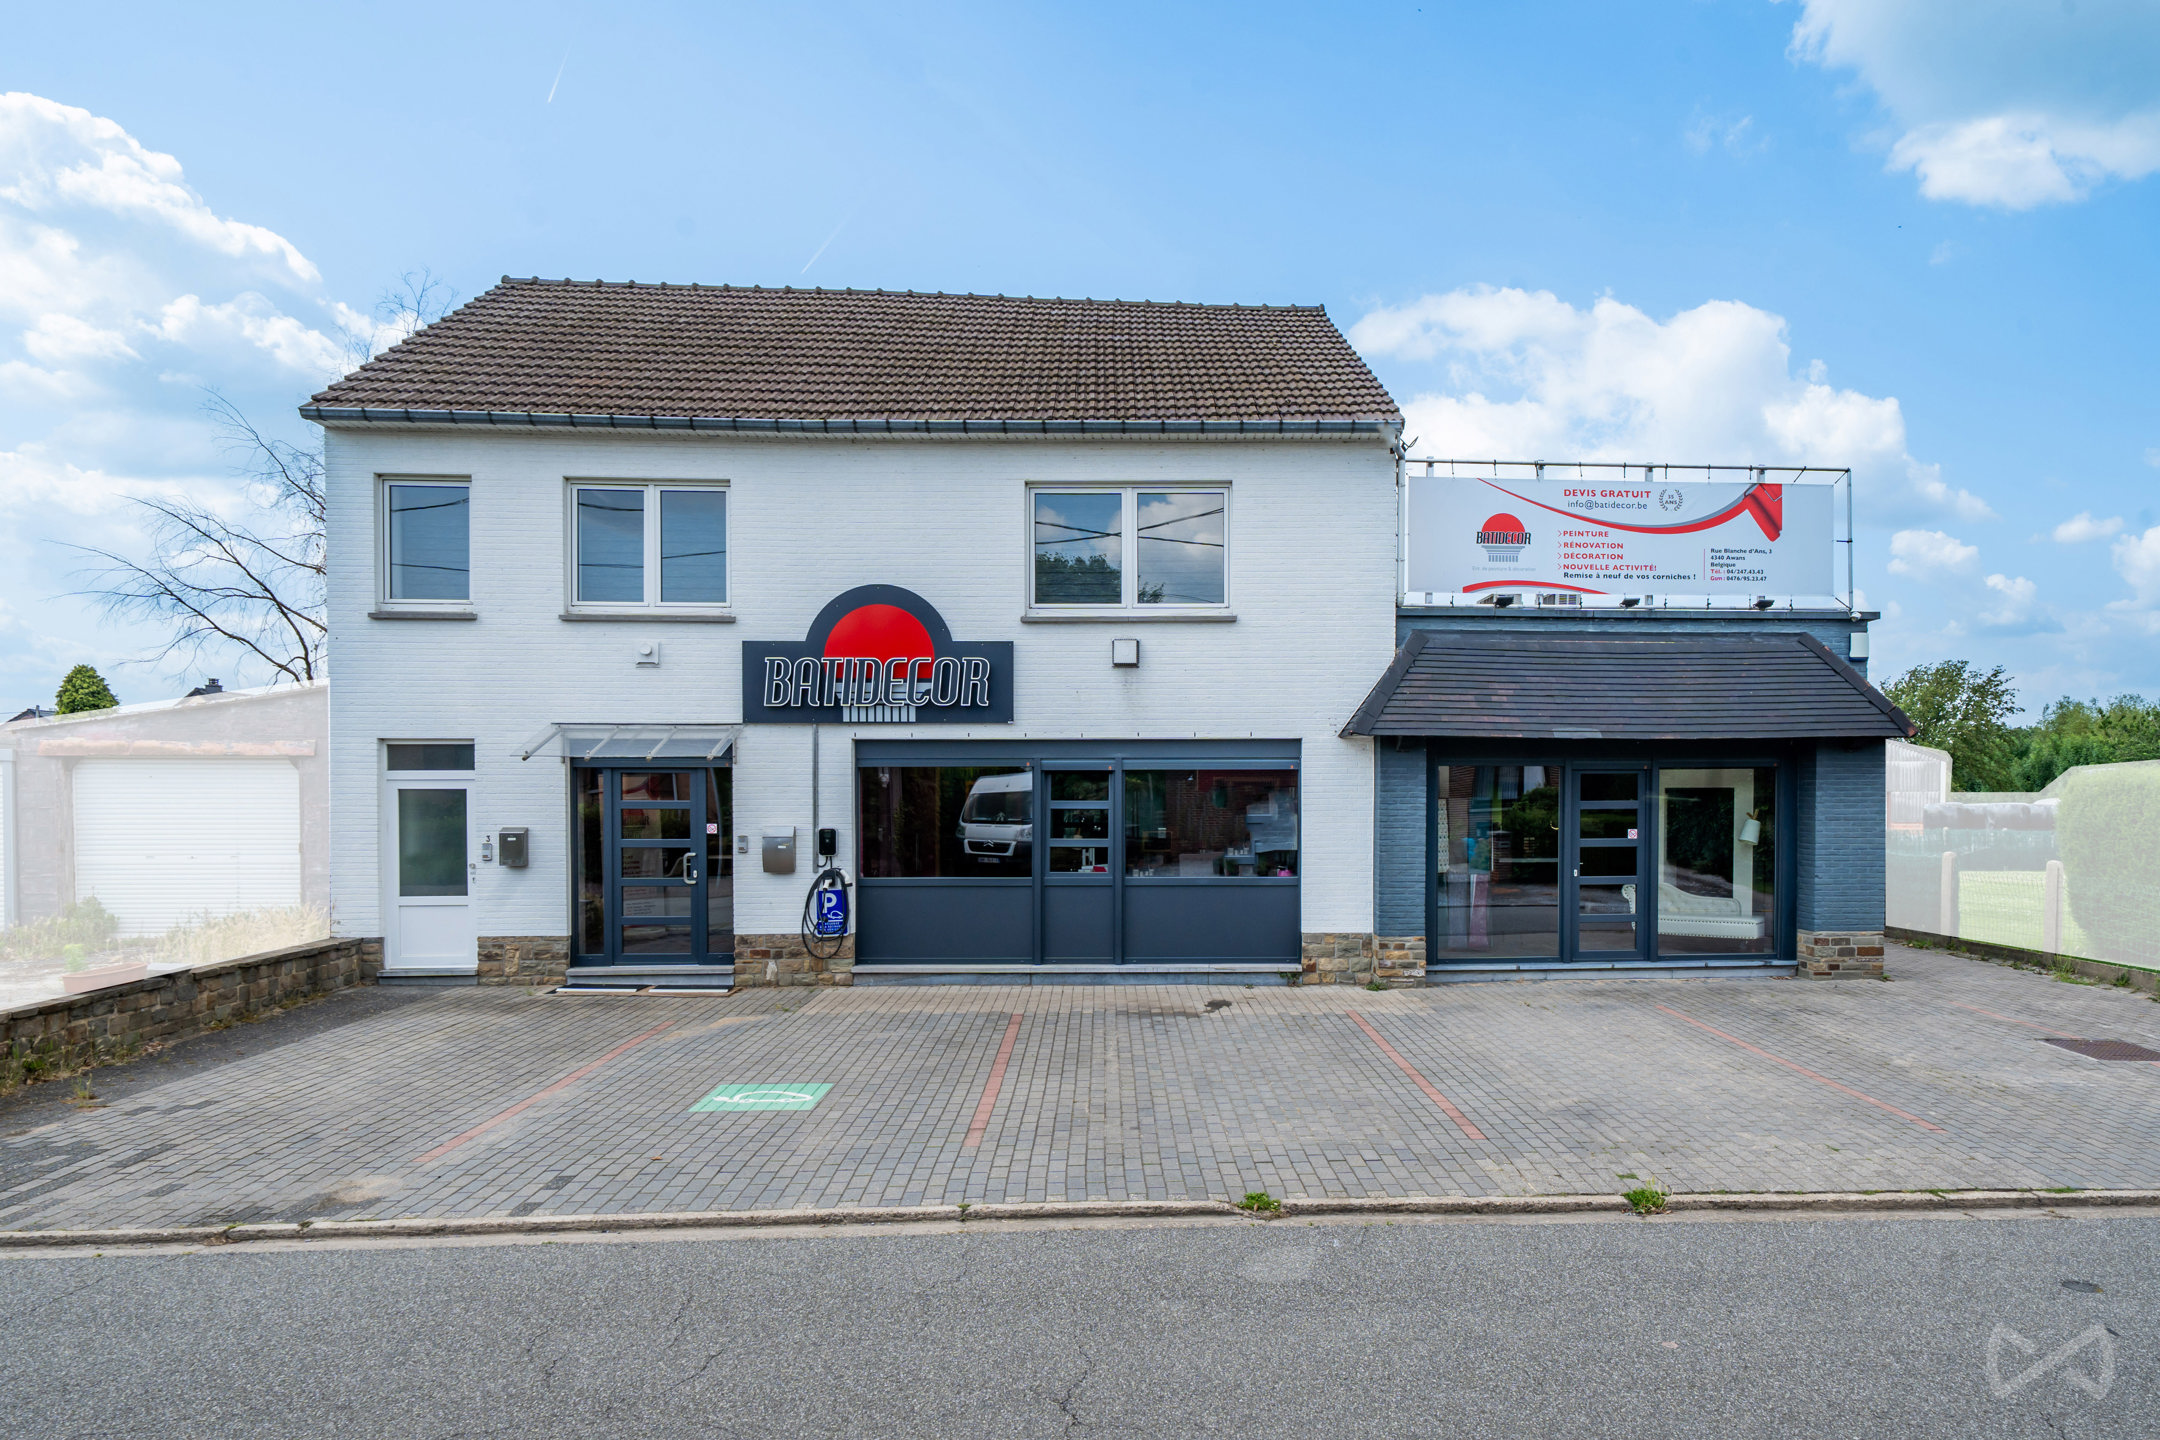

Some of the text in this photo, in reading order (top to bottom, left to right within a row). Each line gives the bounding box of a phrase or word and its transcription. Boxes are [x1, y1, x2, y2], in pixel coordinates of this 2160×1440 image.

[1563, 489, 1652, 498] DEVIS GRATUIT
[1568, 500, 1648, 510] info@batidecor.be
[1476, 532, 1531, 544] BATIDECOR
[1563, 541, 1624, 549] RÉNOVATION
[1563, 552, 1624, 560] DÉCORATION
[1563, 563, 1610, 571] NOUVELLE
[763, 656, 991, 708] BATIDECOR
[822, 892, 837, 914] P
